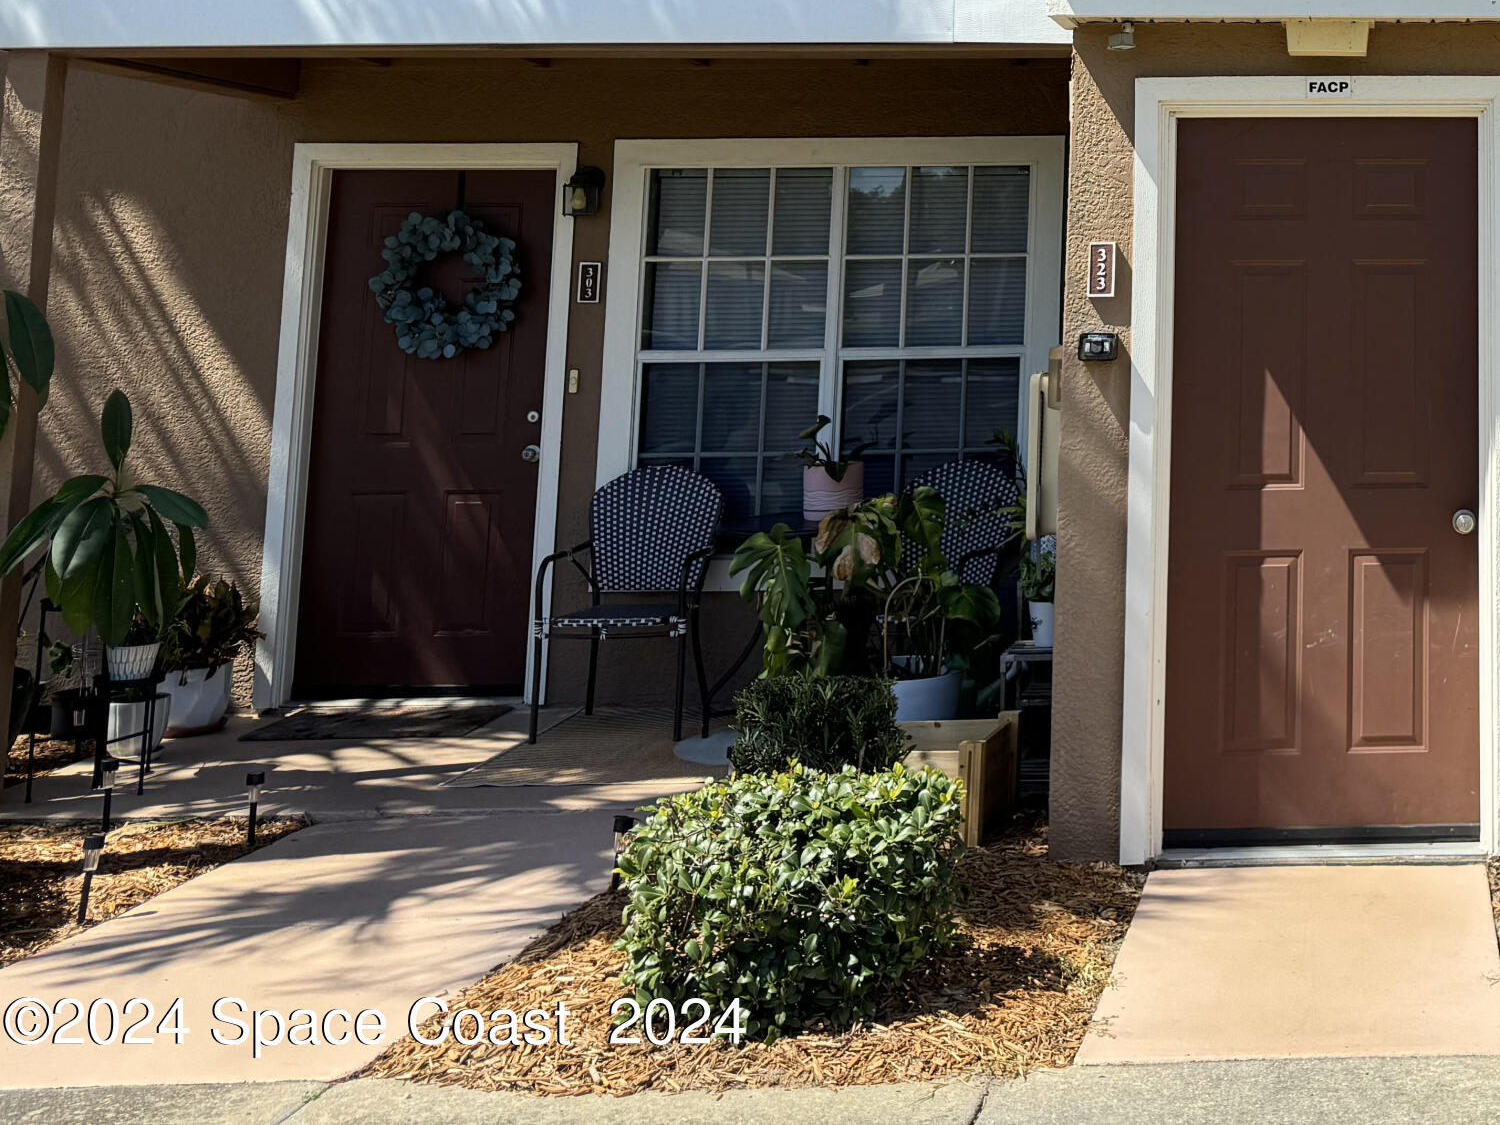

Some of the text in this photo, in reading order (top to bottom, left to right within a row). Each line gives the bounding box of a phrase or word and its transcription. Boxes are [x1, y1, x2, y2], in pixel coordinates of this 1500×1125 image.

[1309, 81, 1349, 93] FACP
[584, 267, 593, 298] 303
[1096, 248, 1107, 290] 323
